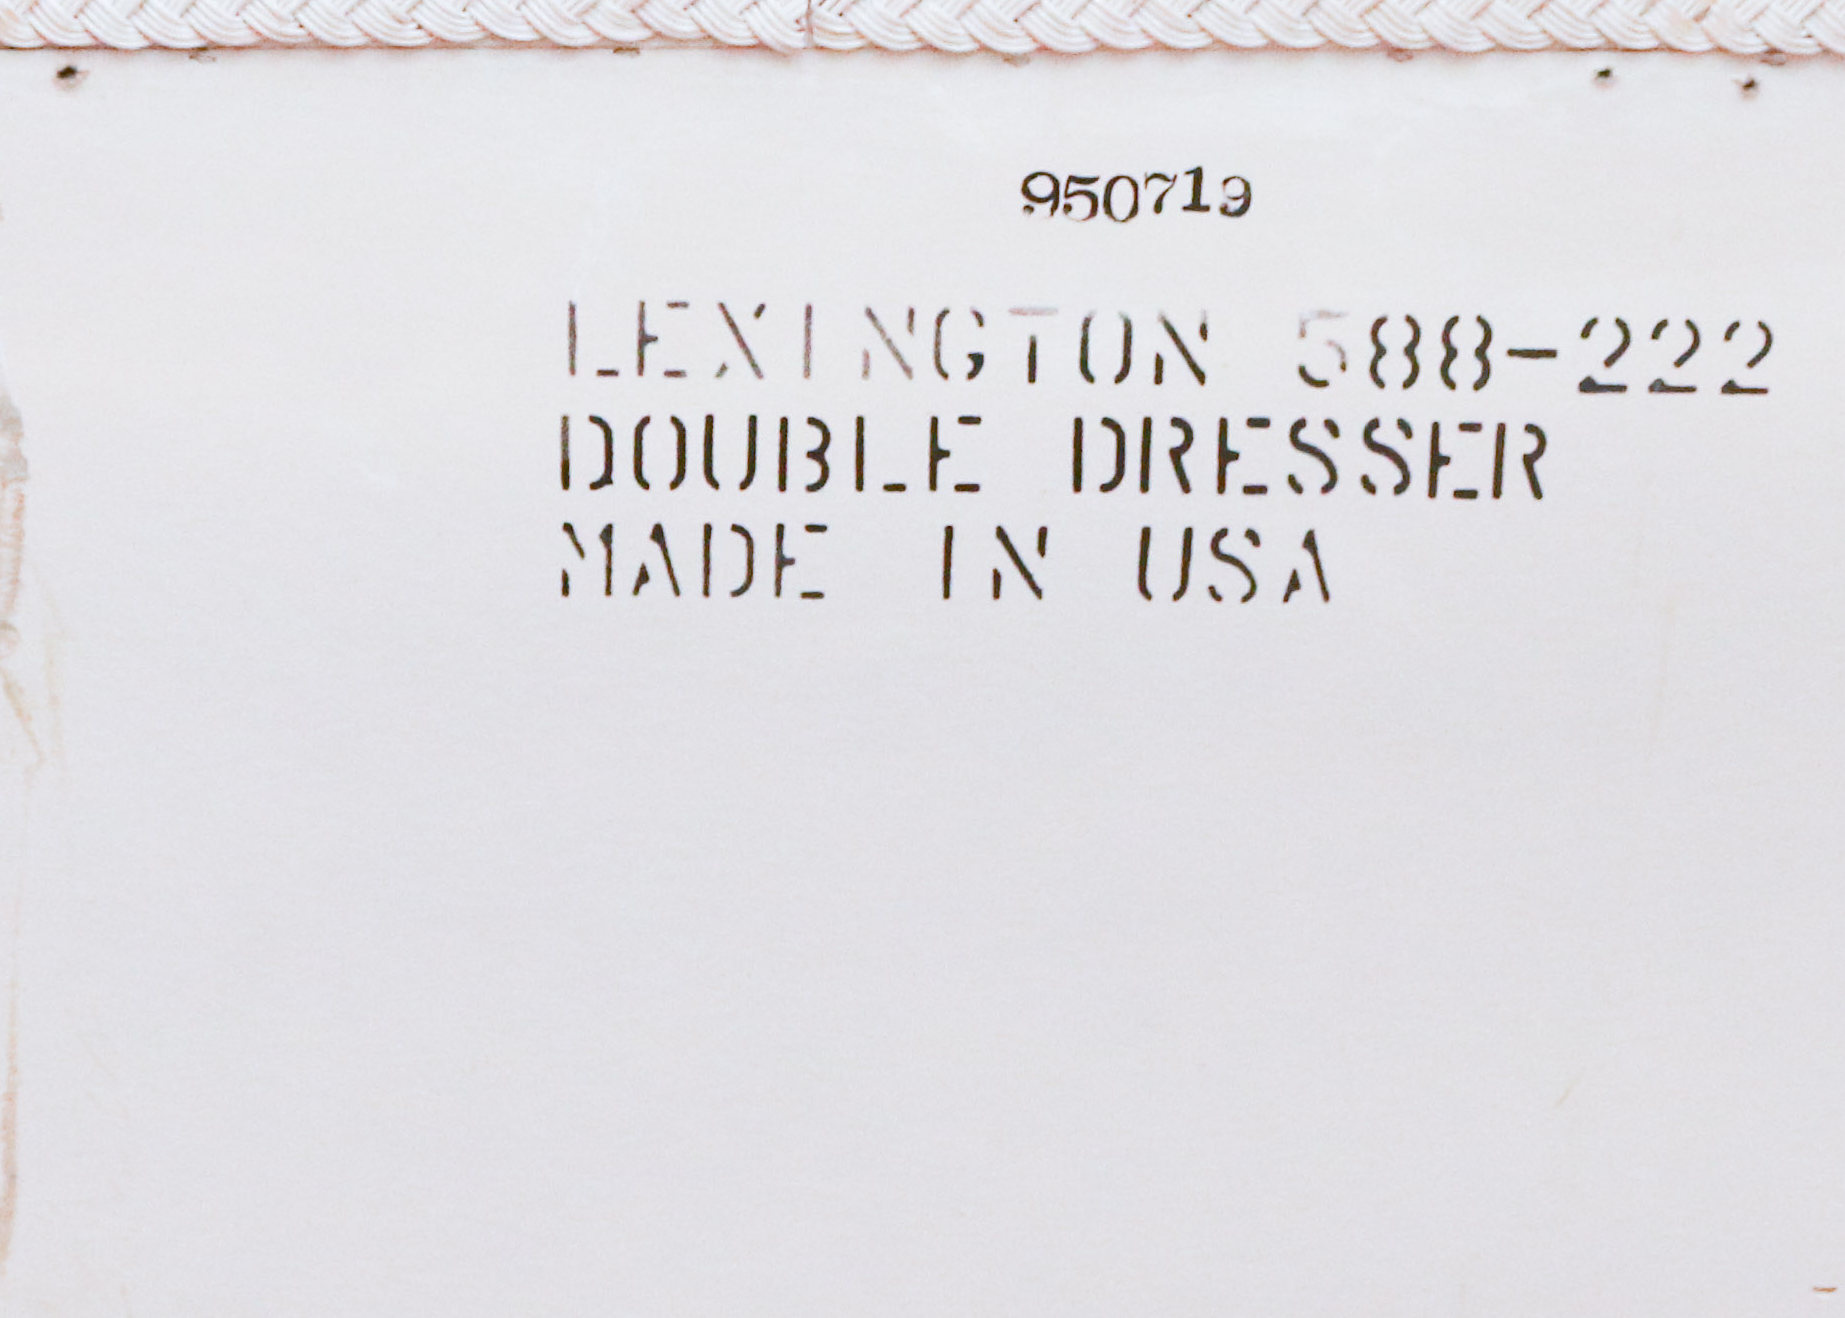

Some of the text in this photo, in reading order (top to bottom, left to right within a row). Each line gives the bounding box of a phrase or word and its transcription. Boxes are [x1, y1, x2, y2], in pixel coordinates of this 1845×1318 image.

[1020, 167, 1252, 223] 950719
[566, 301, 1774, 394] LEXINGTON 588-222
[560, 415, 1547, 501] DOUBLE DRESSER
[561, 522, 1333, 603] MADE IN USA
